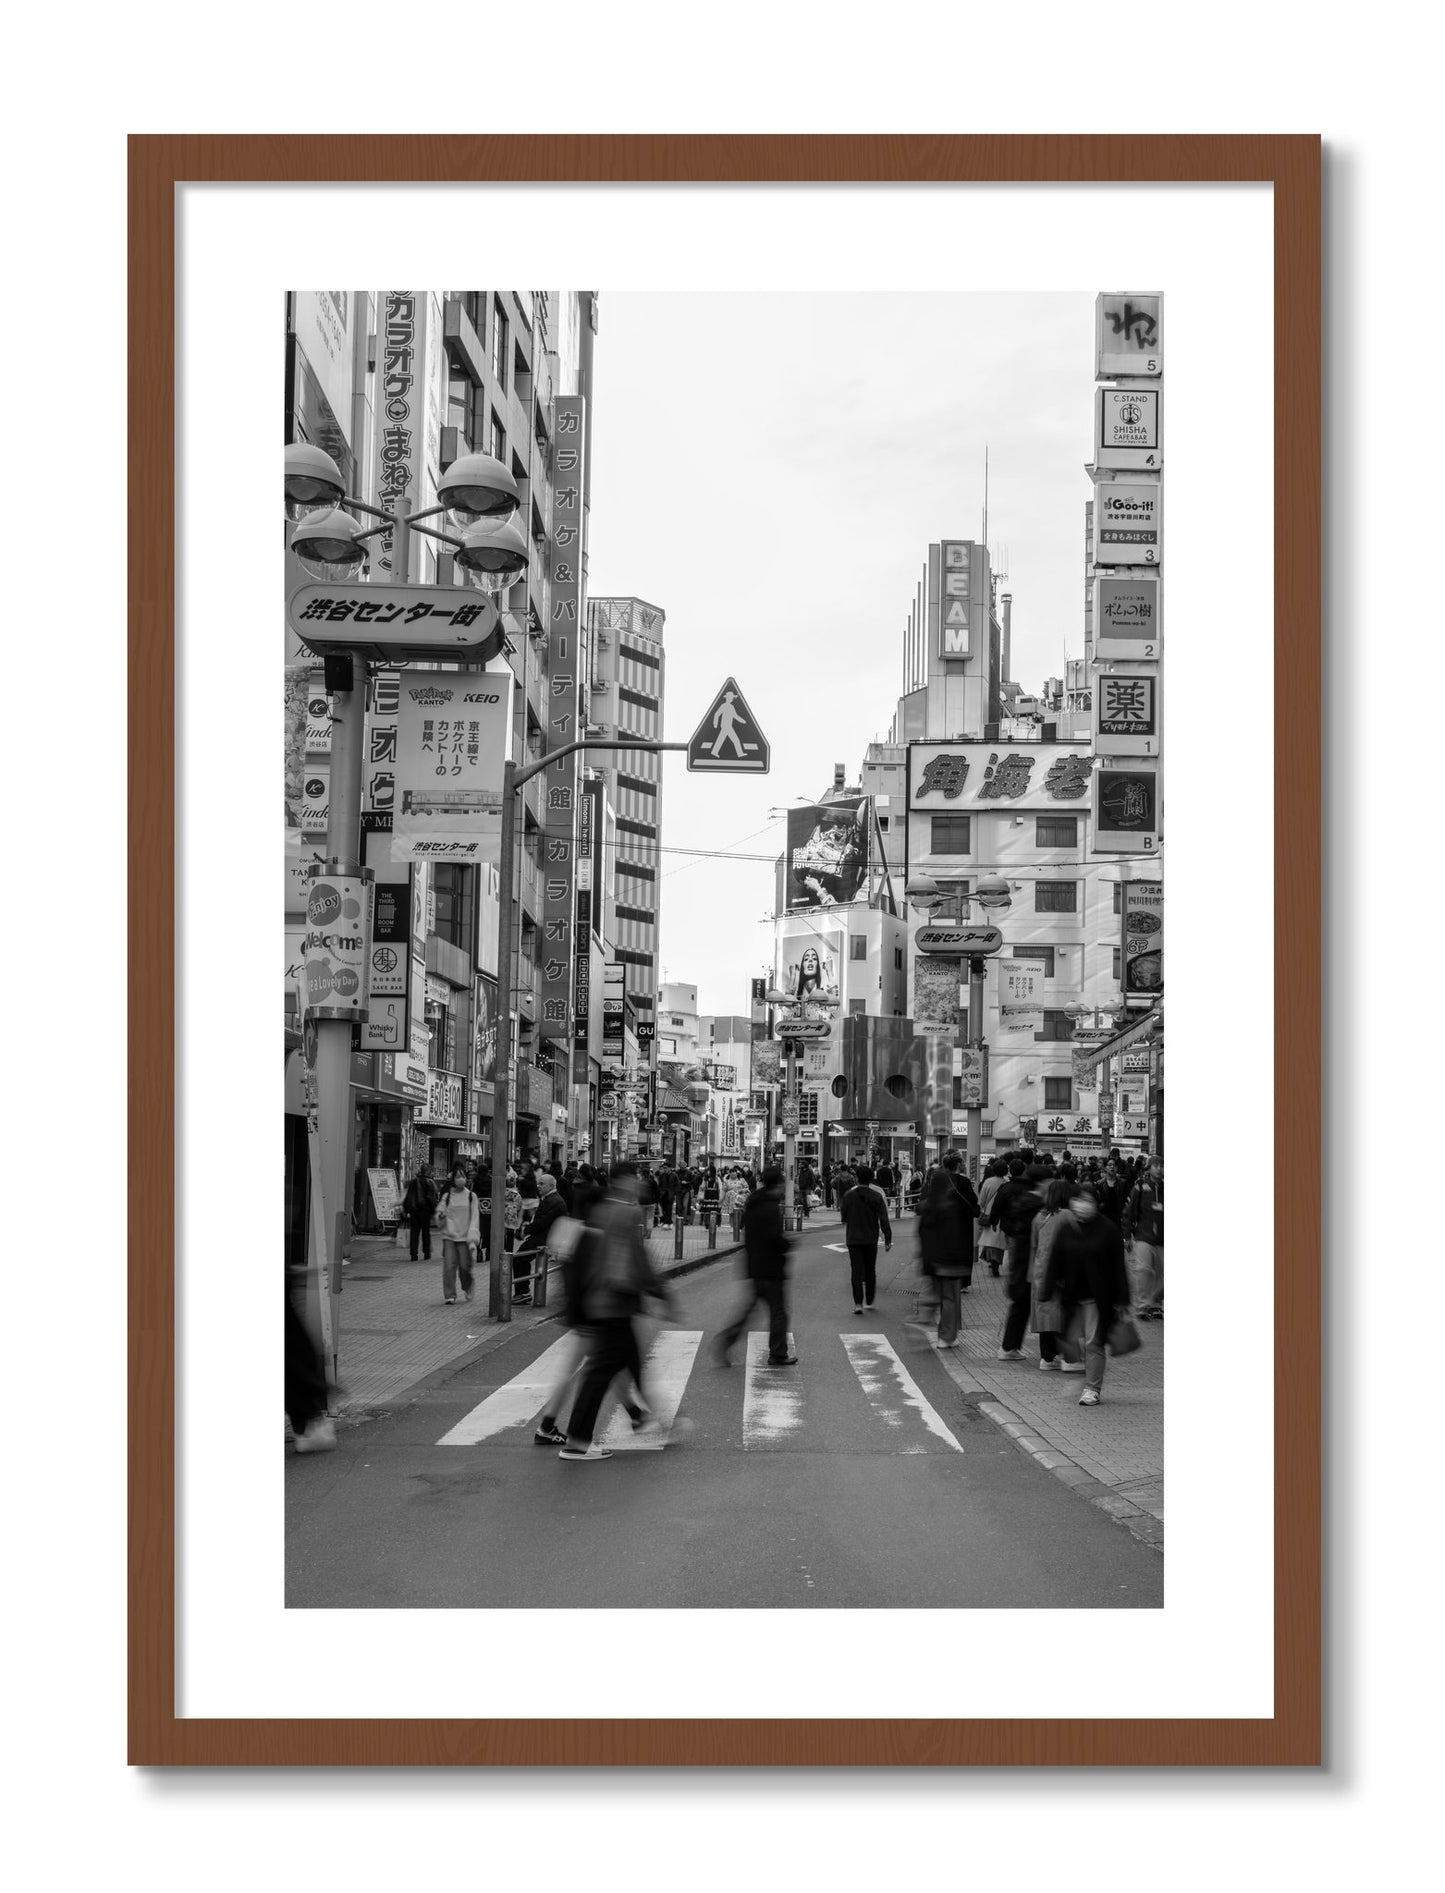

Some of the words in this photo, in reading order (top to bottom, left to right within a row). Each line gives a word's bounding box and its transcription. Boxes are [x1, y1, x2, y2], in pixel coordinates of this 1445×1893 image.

[385, 297, 415, 399] カラオケ
[1147, 360, 1157, 371] 5
[1113, 425, 1148, 434] SHISHA
[1146, 454, 1155, 466] 4
[1112, 498, 1154, 511] Goo-it!
[1145, 549, 1154, 561] 3
[945, 544, 970, 653] BEAM
[299, 598, 486, 627] 渋谷センター街
[1145, 645, 1154, 657] 2
[463, 693, 500, 704] KEIO
[1107, 681, 1145, 720] 薬
[422, 719, 434, 752] 冒険へ
[435, 720, 449, 776] カントーの
[467, 721, 480, 766] 京王線で
[1144, 741, 1152, 752] 1
[915, 752, 1093, 800] 角海老
[582, 798, 590, 825] kimono
[411, 842, 480, 852] 渋谷センター街
[1143, 837, 1153, 849] B
[309, 893, 340, 921] Enjoy
[306, 931, 363, 950] Welcome
[920, 932, 998, 943] 渋谷センター街
[1126, 938, 1149, 954] 6F
[369, 1024, 394, 1033] Whisky
[638, 1027, 654, 1035] GU
[1048, 1116, 1093, 1133] 兆楽
